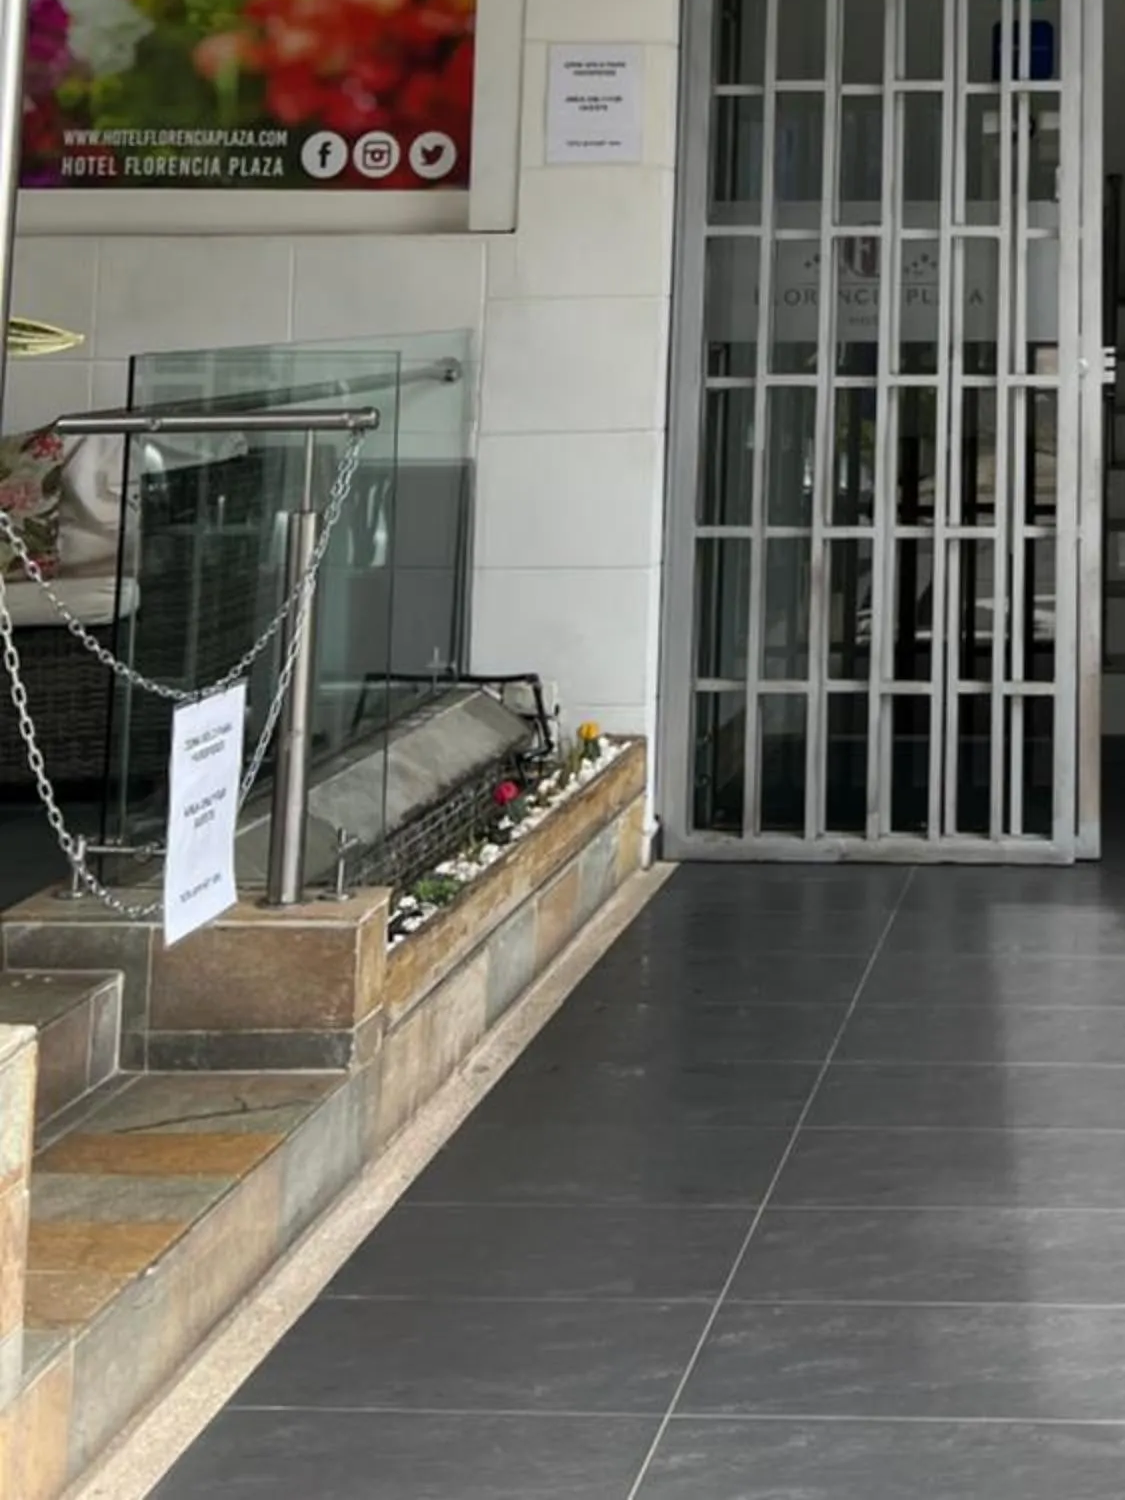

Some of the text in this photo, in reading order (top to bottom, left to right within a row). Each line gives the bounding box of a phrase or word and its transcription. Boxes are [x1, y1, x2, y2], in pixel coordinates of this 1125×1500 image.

[63, 129, 288, 147] WWW.HOTELFLORENCIAPLAZA.COM
[61, 155, 284, 177] HOTEL FLORENCIA PLAZA
